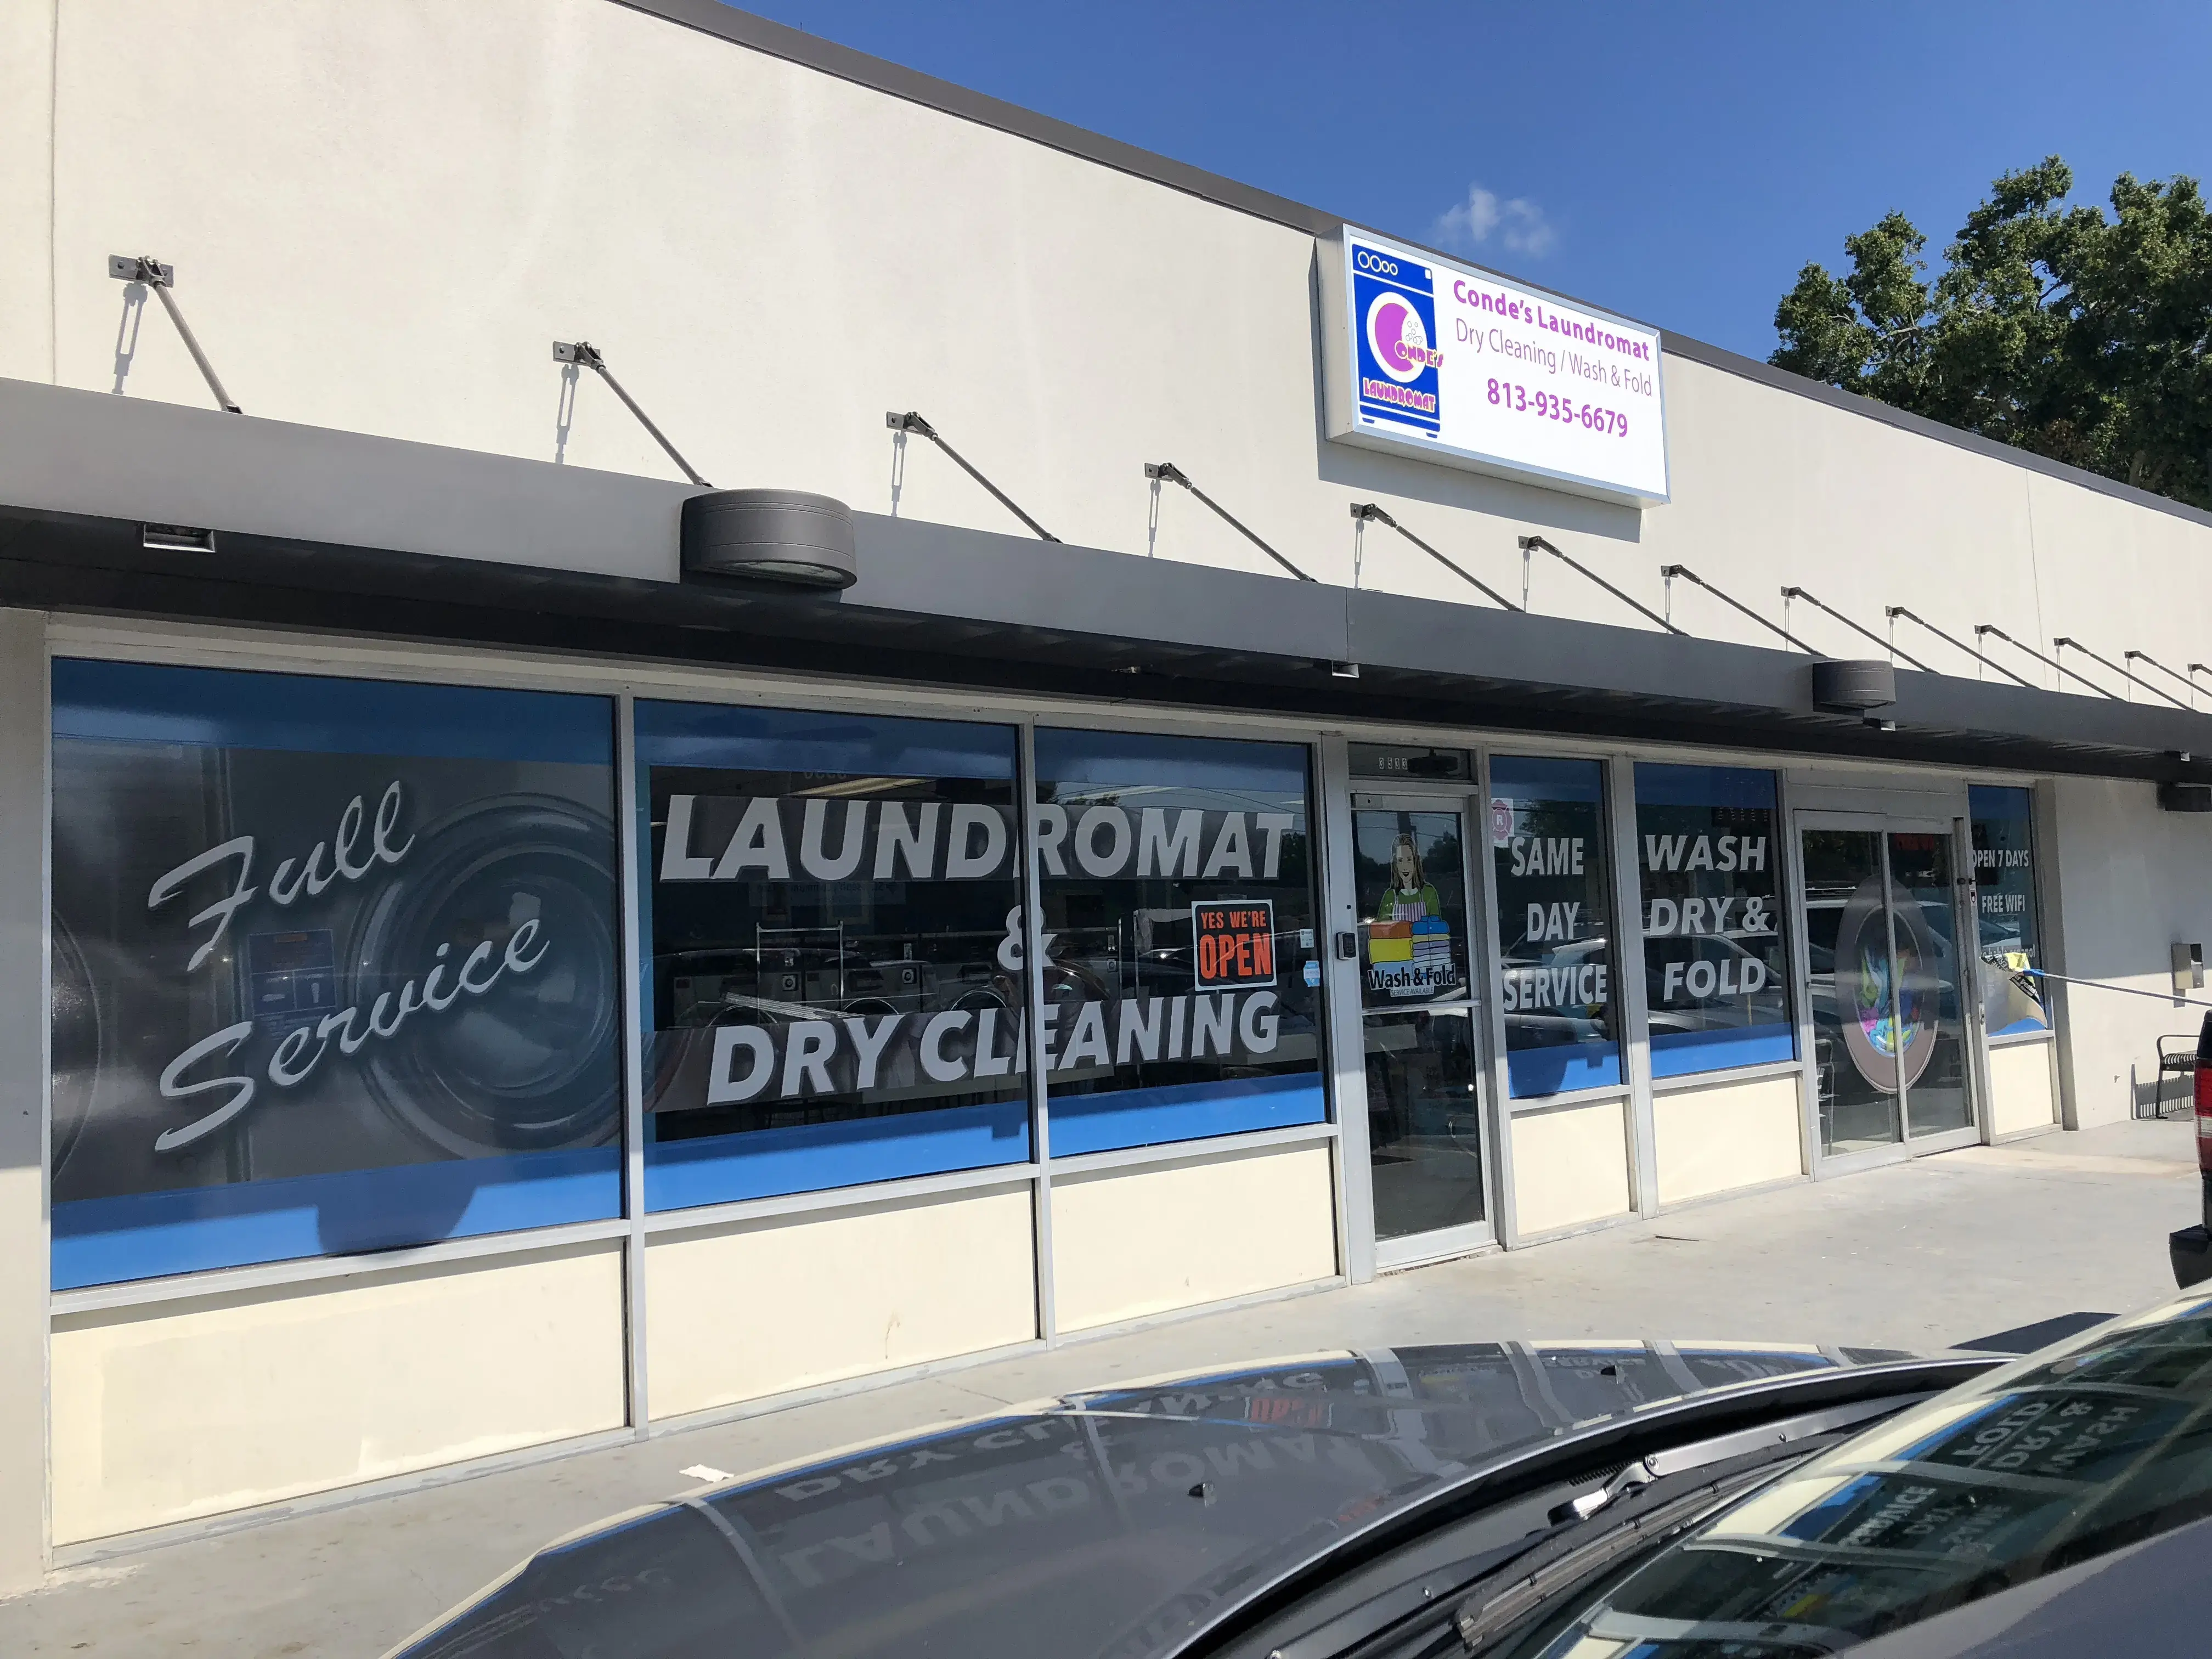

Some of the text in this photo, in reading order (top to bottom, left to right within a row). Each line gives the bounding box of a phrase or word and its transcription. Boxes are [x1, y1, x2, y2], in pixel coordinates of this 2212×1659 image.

[1453, 280, 1650, 362] Conde's Laundromat
[1456, 318, 1652, 397] Dry Cleaning / Wash & Fold
[1363, 377, 1436, 413] LAUNDROMAT
[1487, 378, 1628, 437] 813-935-6679
[1379, 758, 1407, 769] 3533
[660, 794, 1295, 882] LAUNDROMAT
[1511, 837, 1584, 877] SAME
[1645, 834, 1767, 872] WASH
[1997, 849, 2004, 867] 7
[2006, 849, 2029, 867] DAYS
[148, 780, 415, 973] Full
[1200, 910, 1267, 929] YES WE'RE
[1527, 902, 1580, 943] DAY
[1649, 896, 1771, 936] DRY &
[1982, 894, 2025, 913] FREE WIFI
[1199, 933, 1271, 979] OPEN
[1368, 964, 1456, 989] Wash & Fold
[1391, 986, 1434, 996] SERVICE AVAILABLE
[1503, 964, 1607, 1011] SERVICE
[1663, 957, 1767, 1002] FOLD
[154, 918, 551, 1153] Service
[707, 991, 1280, 1106] DRY CLEANING
